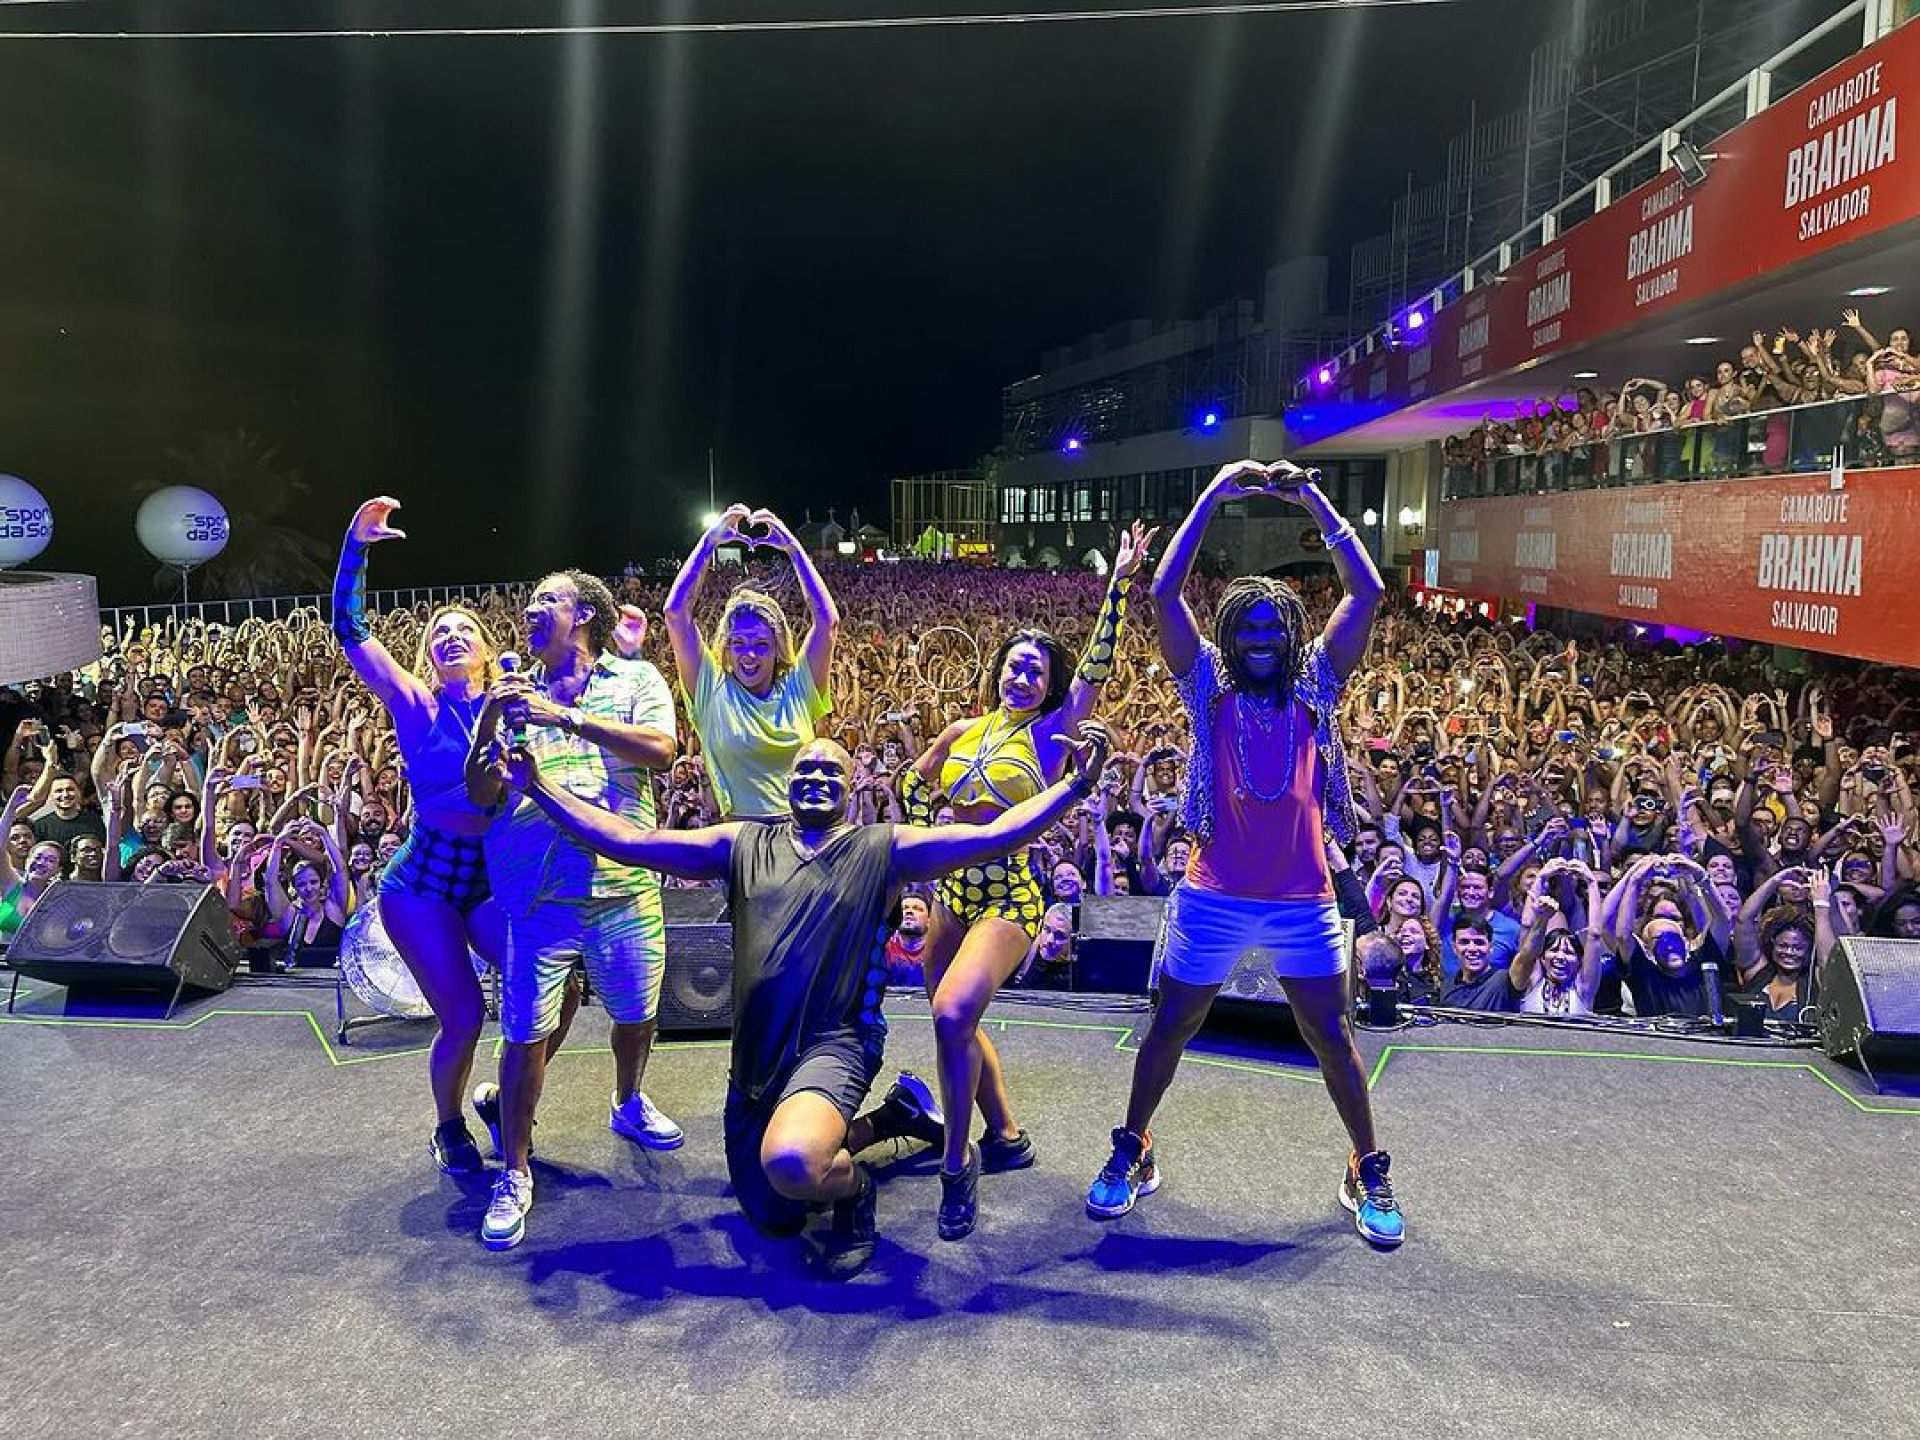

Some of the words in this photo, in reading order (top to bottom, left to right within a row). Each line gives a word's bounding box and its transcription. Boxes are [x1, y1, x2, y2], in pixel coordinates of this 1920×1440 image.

[1808, 61, 1883, 129] CAMAROTE
[1785, 97, 1897, 208] BRAHMA
[1627, 204, 1693, 281] BRAHMA
[1799, 185, 1871, 241] SALVADOR
[1780, 493, 1849, 524] CAMAROTE
[1610, 532, 1672, 580] BRAHMA
[1758, 534, 1862, 597] BRAHMA
[1771, 600, 1839, 635] SALVADOR
